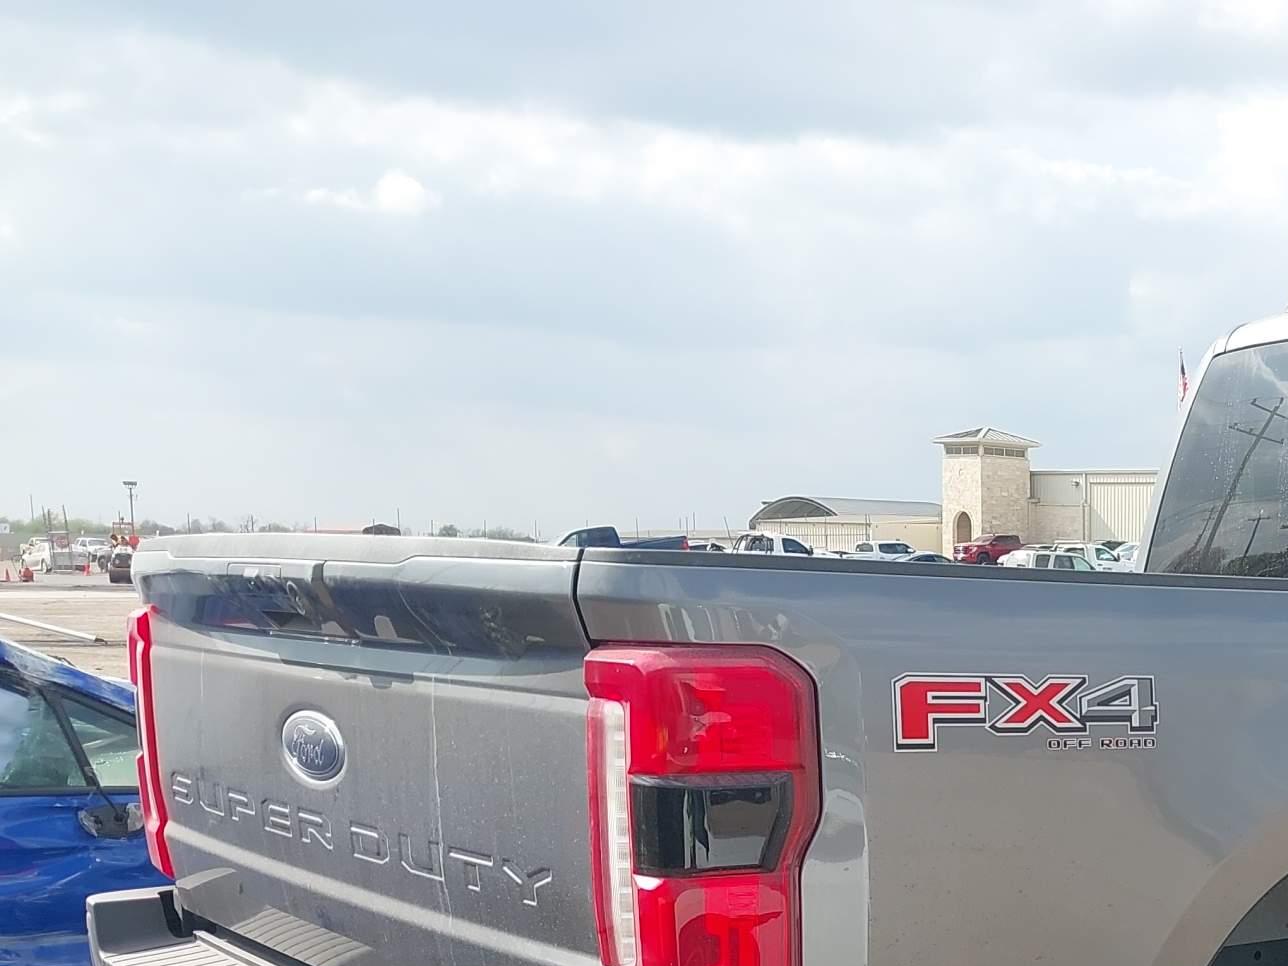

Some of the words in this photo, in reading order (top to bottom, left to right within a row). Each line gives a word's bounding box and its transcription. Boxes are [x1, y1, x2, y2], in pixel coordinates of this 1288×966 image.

[891, 672, 1159, 752] FX4
[292, 724, 325, 766] Ford
[1047, 737, 1093, 750] OFF
[1099, 737, 1158, 750] ROAD
[171, 771, 333, 850] SUPER
[350, 820, 553, 906] DUTY
